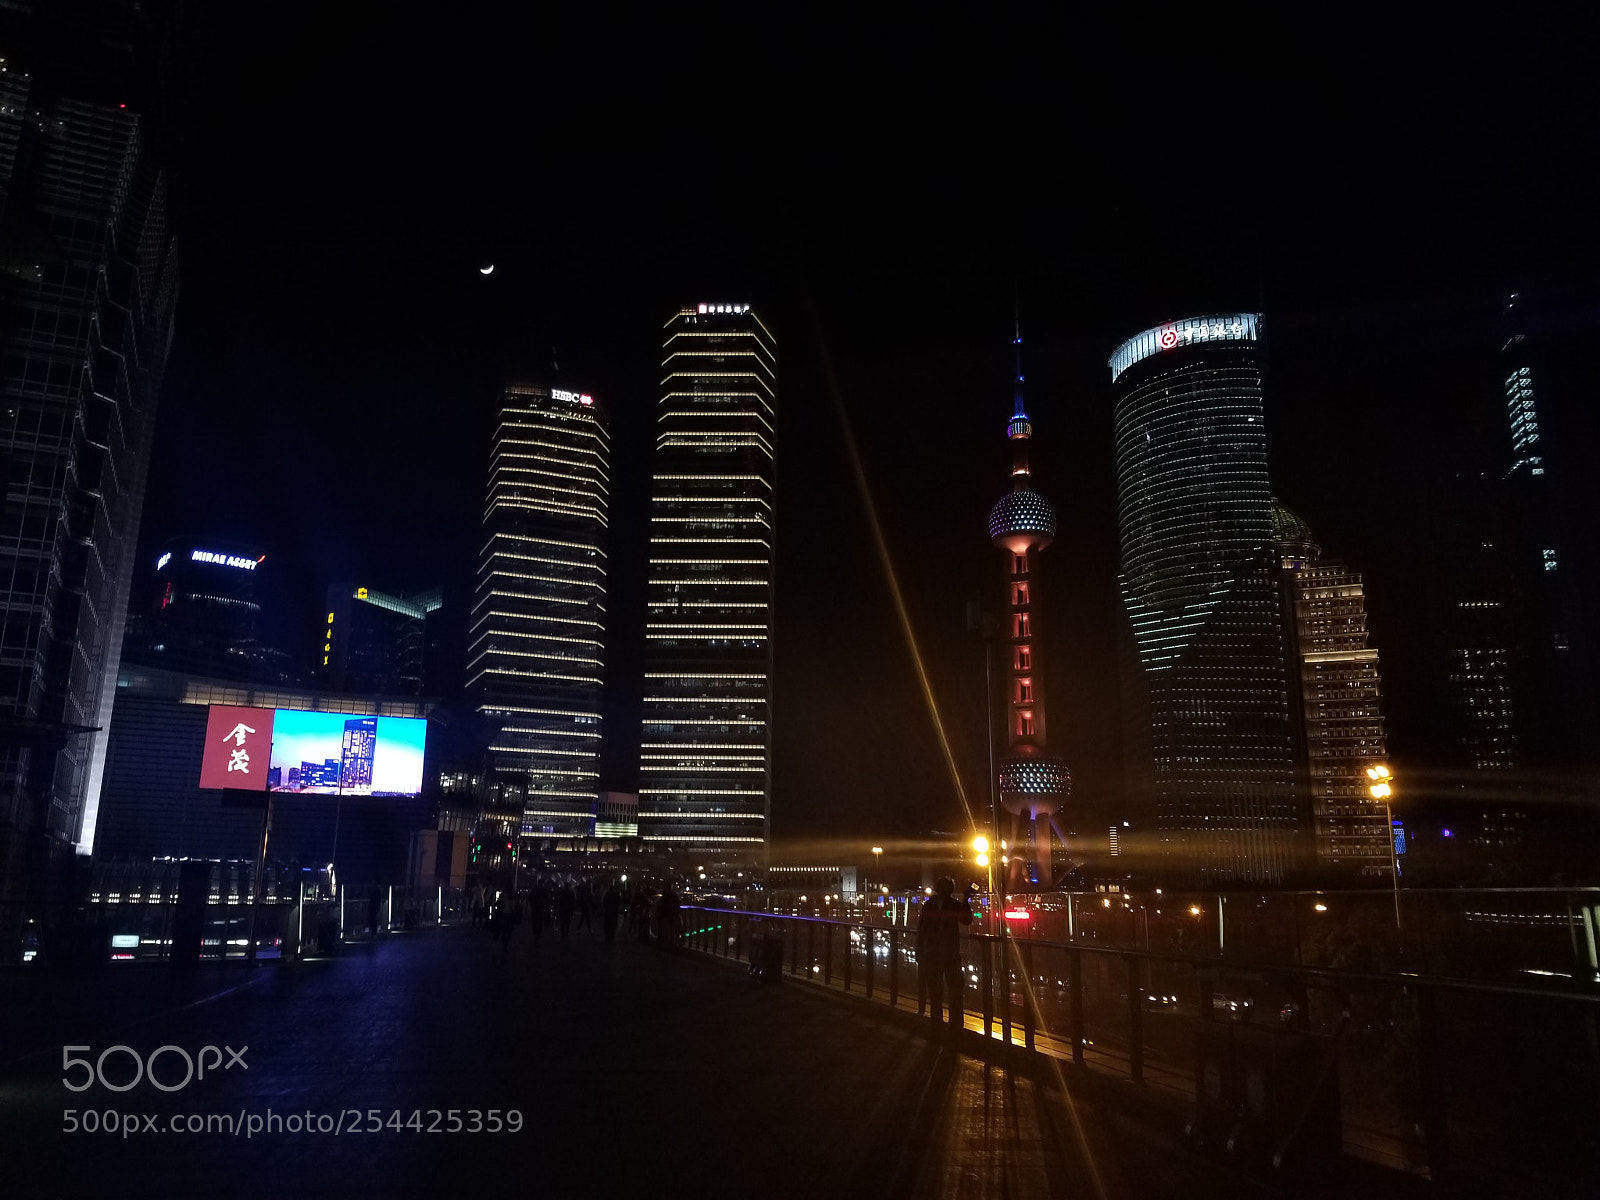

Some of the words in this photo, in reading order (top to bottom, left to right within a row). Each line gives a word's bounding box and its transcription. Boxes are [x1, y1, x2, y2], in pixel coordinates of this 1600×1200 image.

[551, 389, 580, 403] HSBC
[191, 550, 227, 565] MIRAE
[226, 556, 258, 570] ASSET
[222, 722, 256, 774] 金茂
